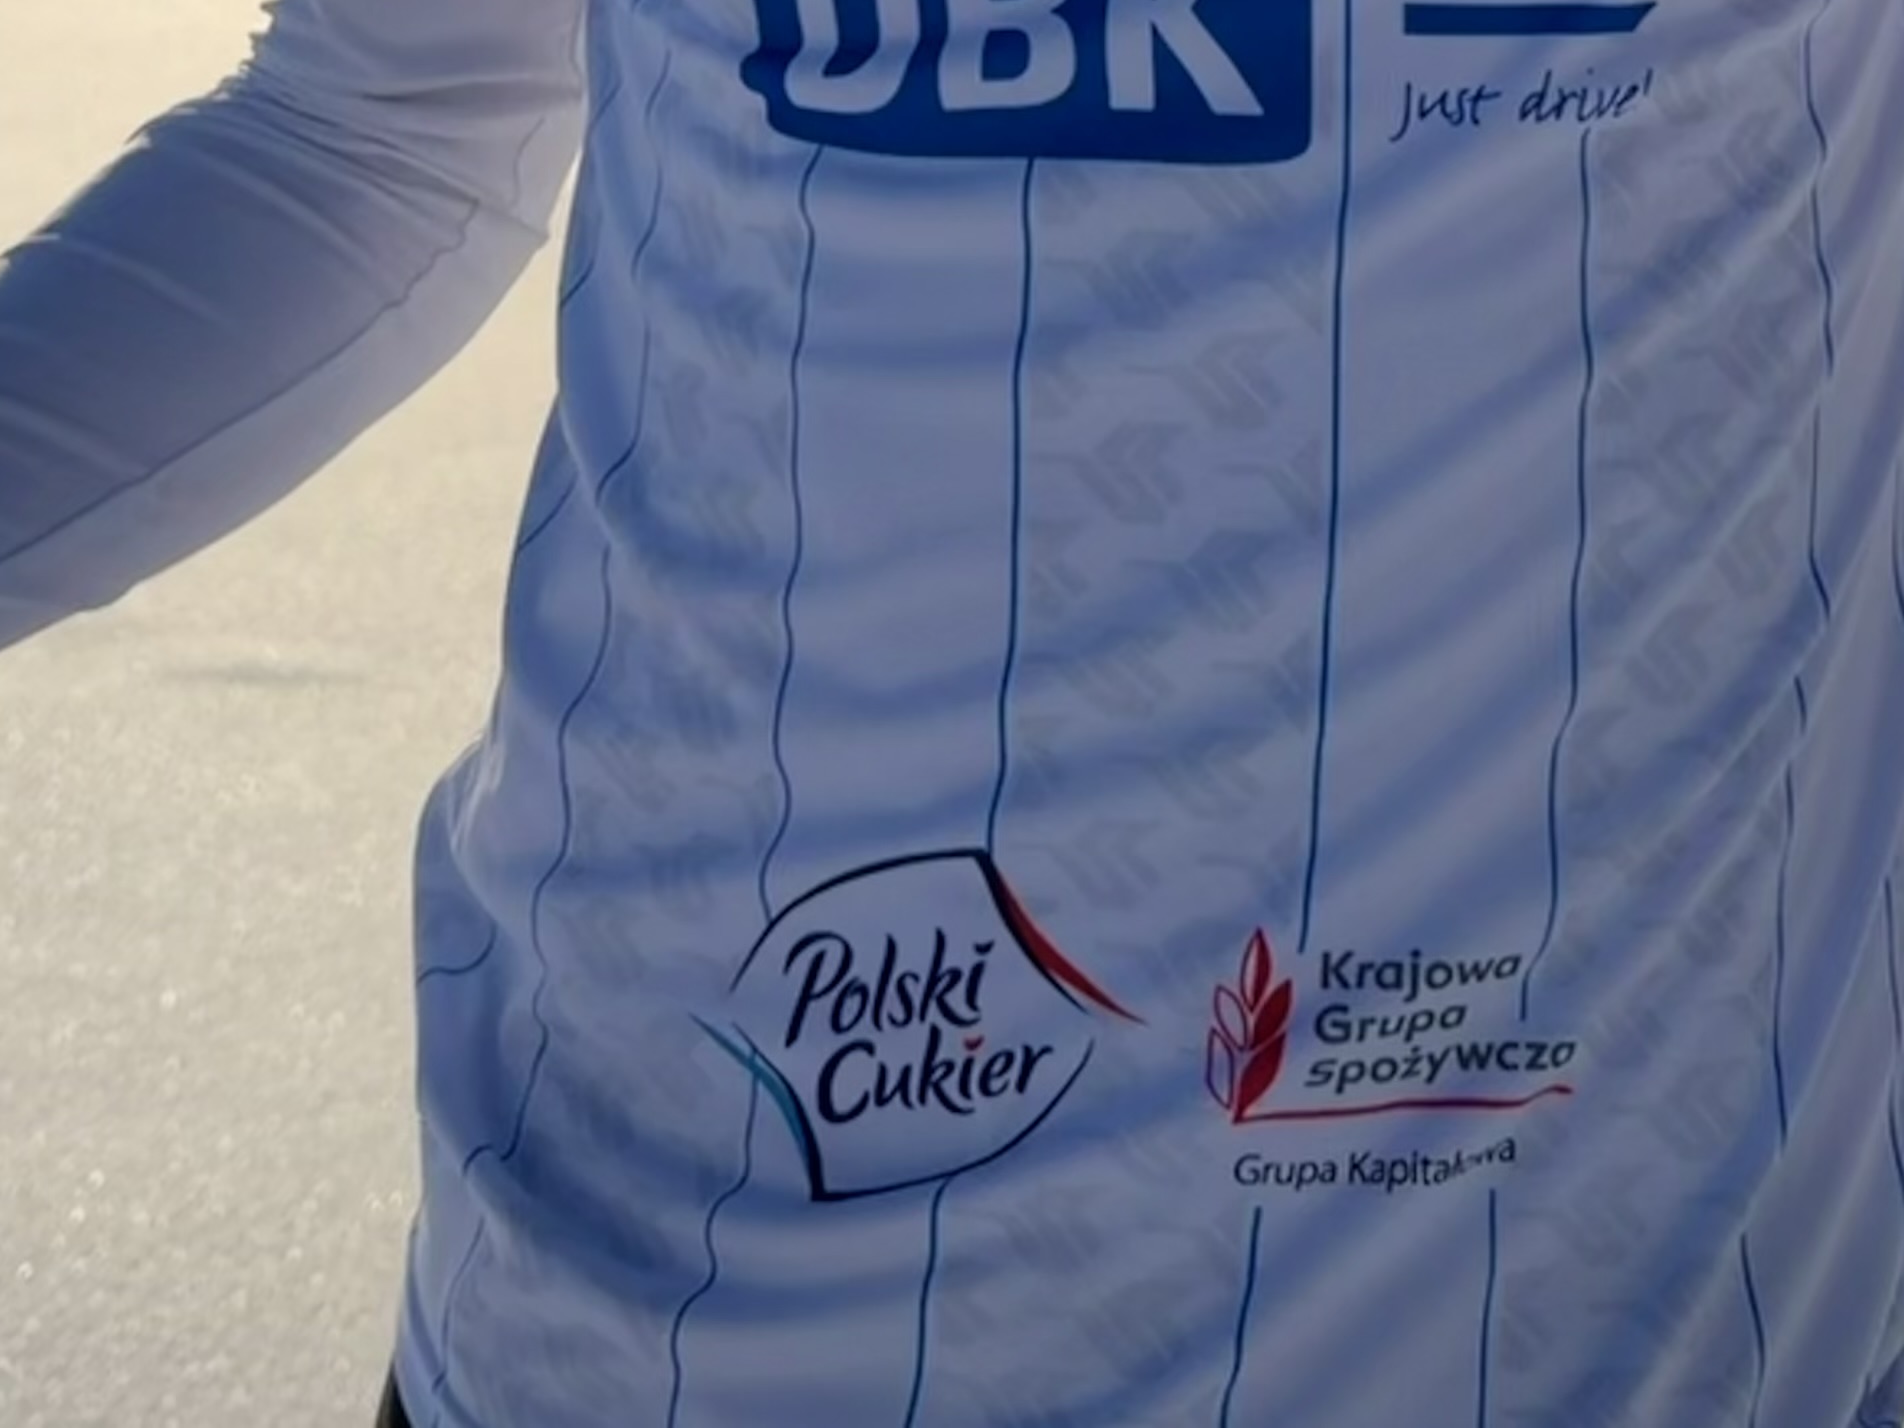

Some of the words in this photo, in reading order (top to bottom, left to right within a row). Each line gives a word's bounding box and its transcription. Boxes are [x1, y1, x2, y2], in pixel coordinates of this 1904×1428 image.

[783, 927, 995, 1049] Polski
[1319, 949, 1523, 1002] Krajowa
[1314, 1002, 1469, 1046] Grupa
[816, 1024, 1054, 1125] Cukier
[1233, 1152, 1337, 1192] Grupa
